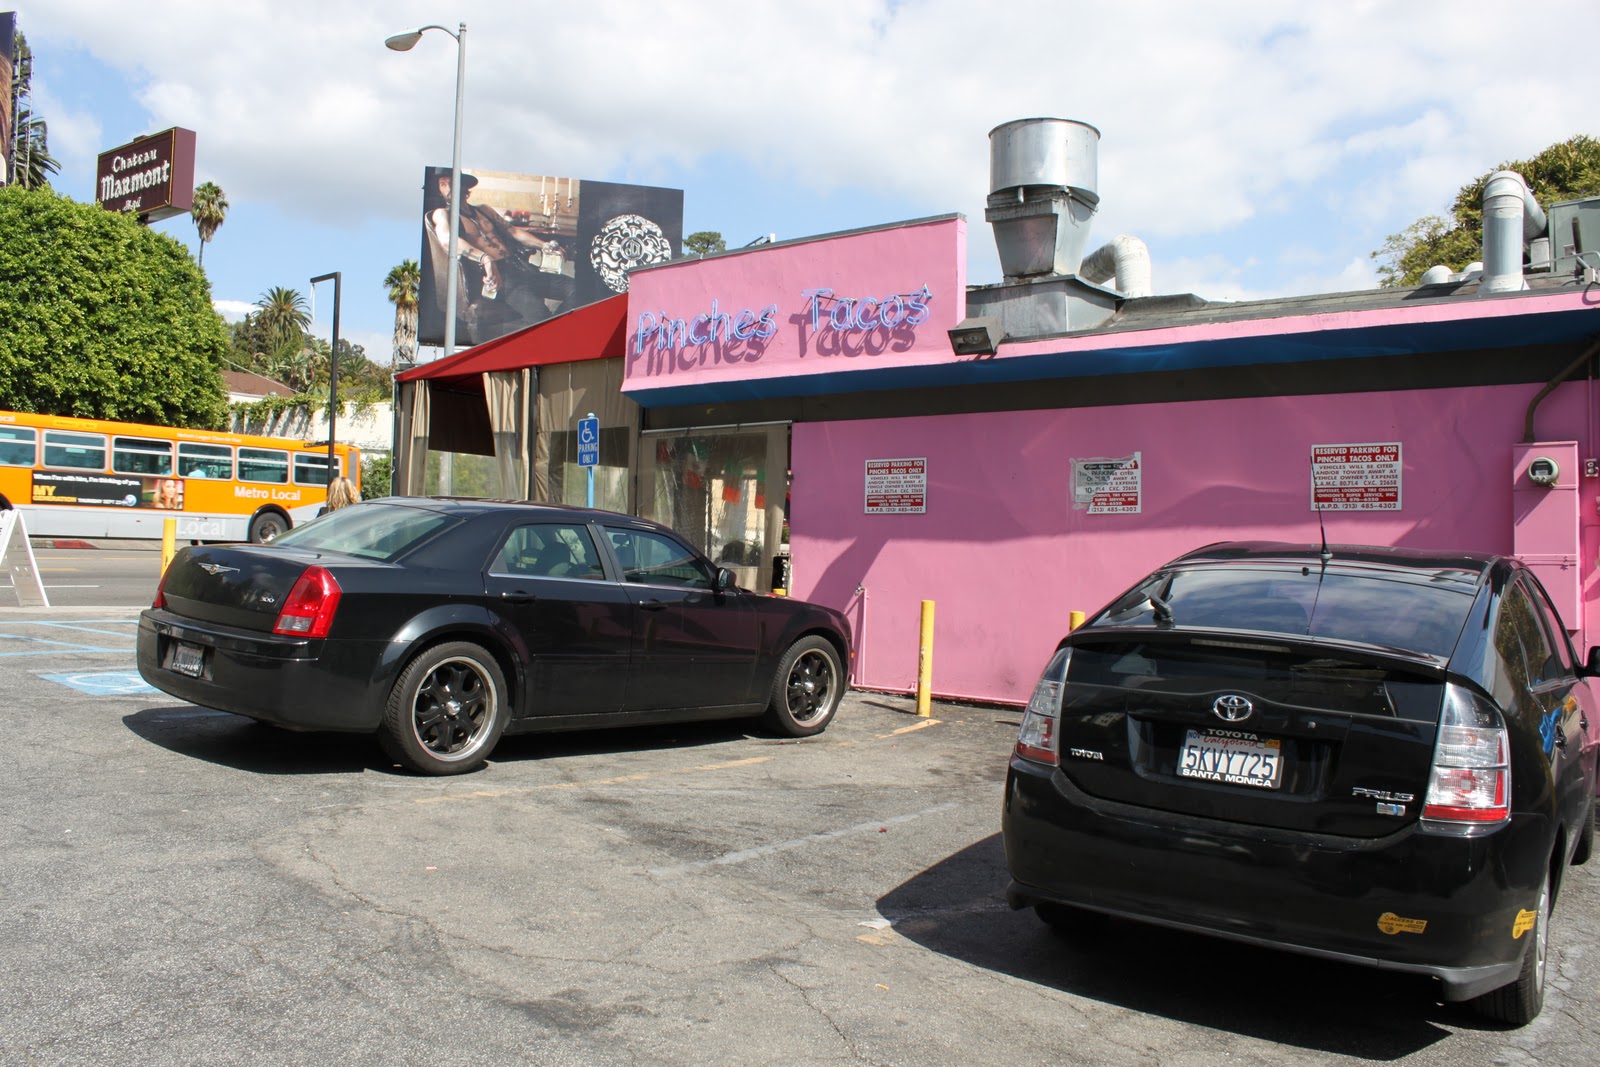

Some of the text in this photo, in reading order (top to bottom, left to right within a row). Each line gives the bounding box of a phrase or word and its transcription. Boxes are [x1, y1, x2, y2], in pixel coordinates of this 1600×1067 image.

[112, 149, 157, 172] Chateau
[101, 160, 170, 201] Marmont
[637, 283, 932, 353] Pinches Tacos
[579, 443, 597, 452] PARKING
[583, 454, 594, 463] ONLY
[33, 485, 56, 496] MY
[234, 486, 300, 500] Metro Local
[177, 518, 226, 536] Local
[1207, 728, 1258, 740] TOYOTA
[1186, 745, 1274, 779] 5KVY725
[1182, 769, 1272, 787] SANTA MONICA
[1352, 787, 1414, 802] PRIUS
